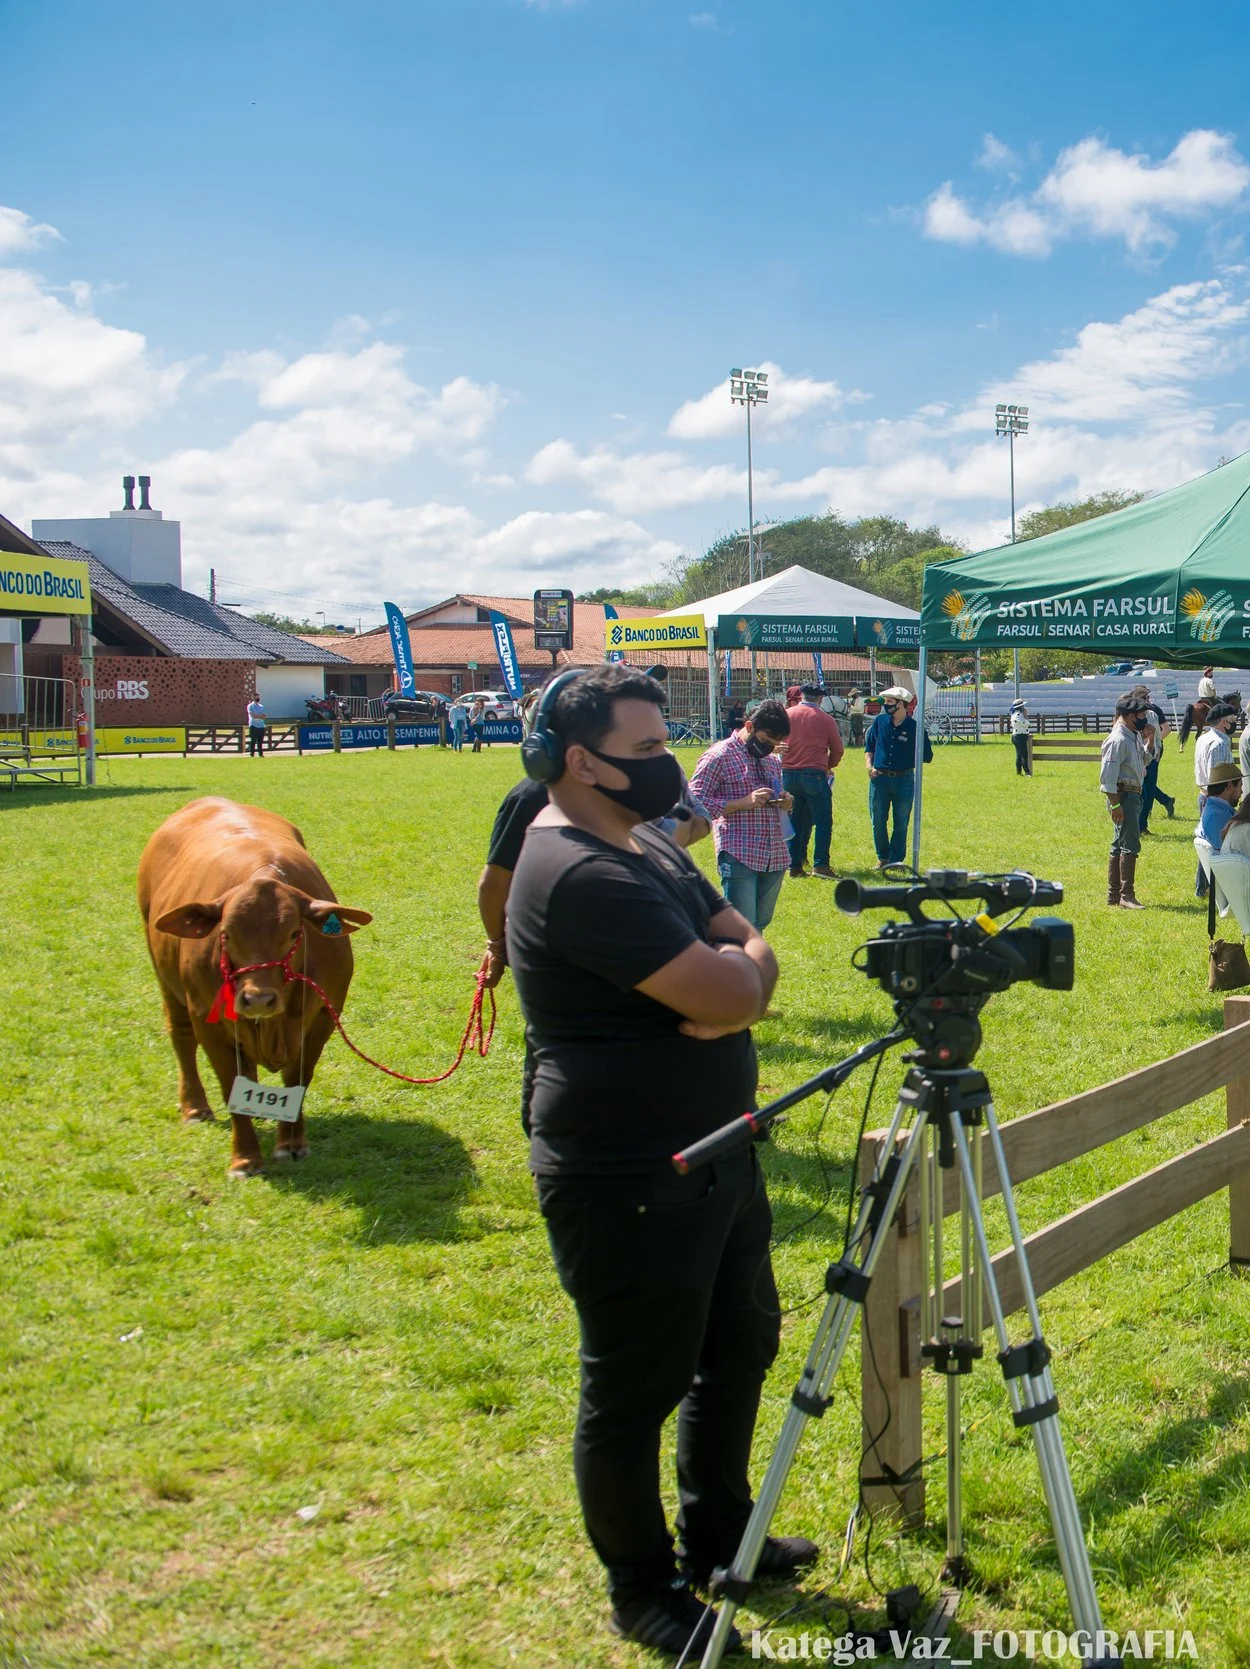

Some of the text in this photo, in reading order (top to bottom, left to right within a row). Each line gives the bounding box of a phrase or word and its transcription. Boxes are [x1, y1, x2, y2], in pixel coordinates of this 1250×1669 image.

[26, 573, 41, 596] DO
[44, 571, 84, 599] BRASIL
[997, 597, 1174, 618] SISTEMA FARSUL
[625, 625, 700, 642] BANCO DO BRASIL
[762, 624, 839, 634] SISTEMA FARSUL
[896, 625, 921, 636] SISTE
[997, 622, 1174, 636] FARSUL SENAR CASA RURAL
[117, 680, 149, 700] RBS
[308, 727, 441, 740] NUTRIEX ALTO DSEMPENH
[511, 725, 520, 735] O
[243, 1089, 289, 1107] 1191
